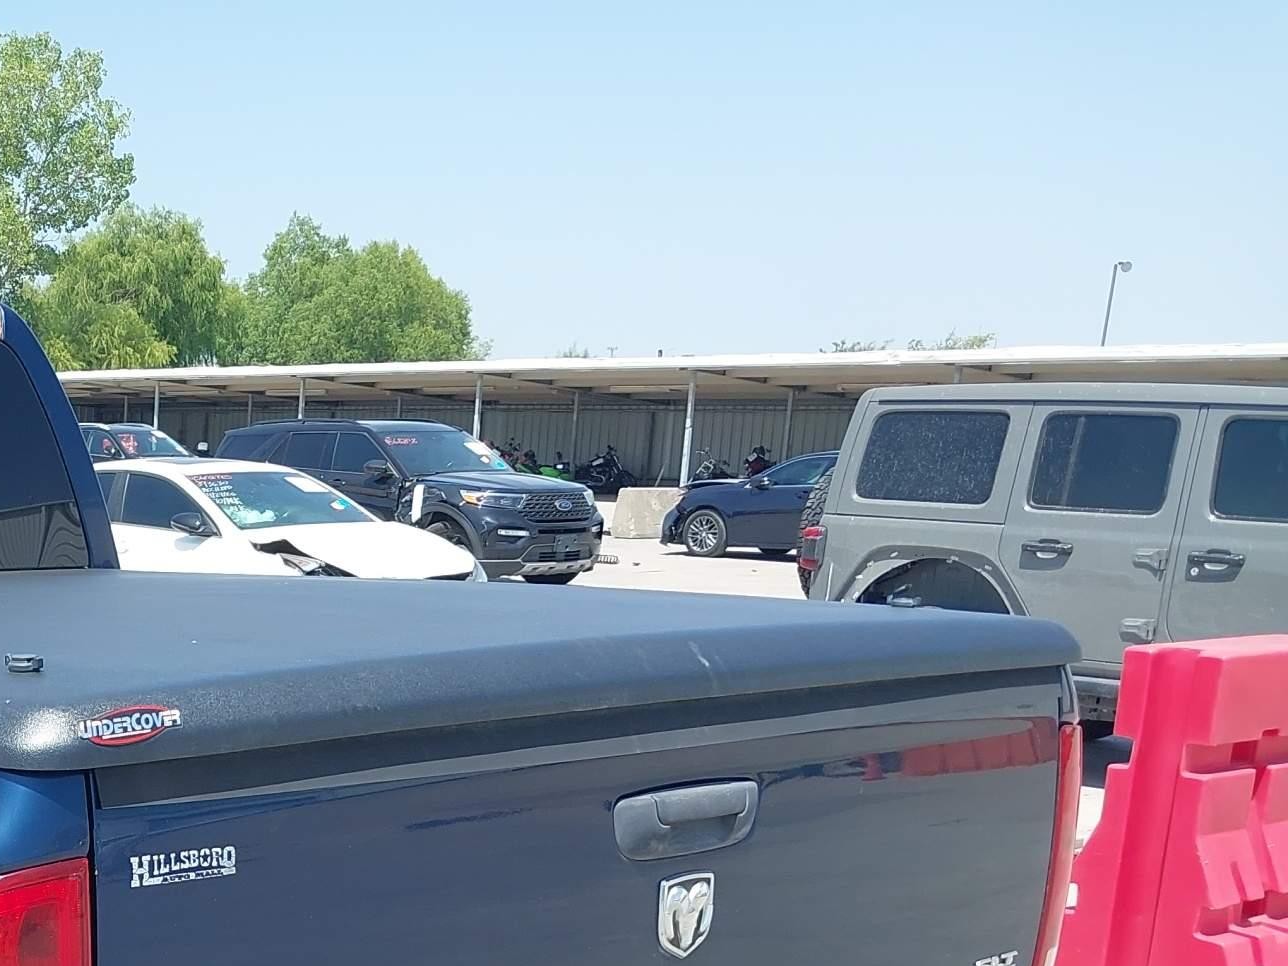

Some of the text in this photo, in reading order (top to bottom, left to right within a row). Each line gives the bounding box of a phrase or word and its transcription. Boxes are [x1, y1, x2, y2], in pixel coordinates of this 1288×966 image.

[130, 845, 237, 888] HILLSBORO
[161, 868, 224, 885] AUTO MALL
